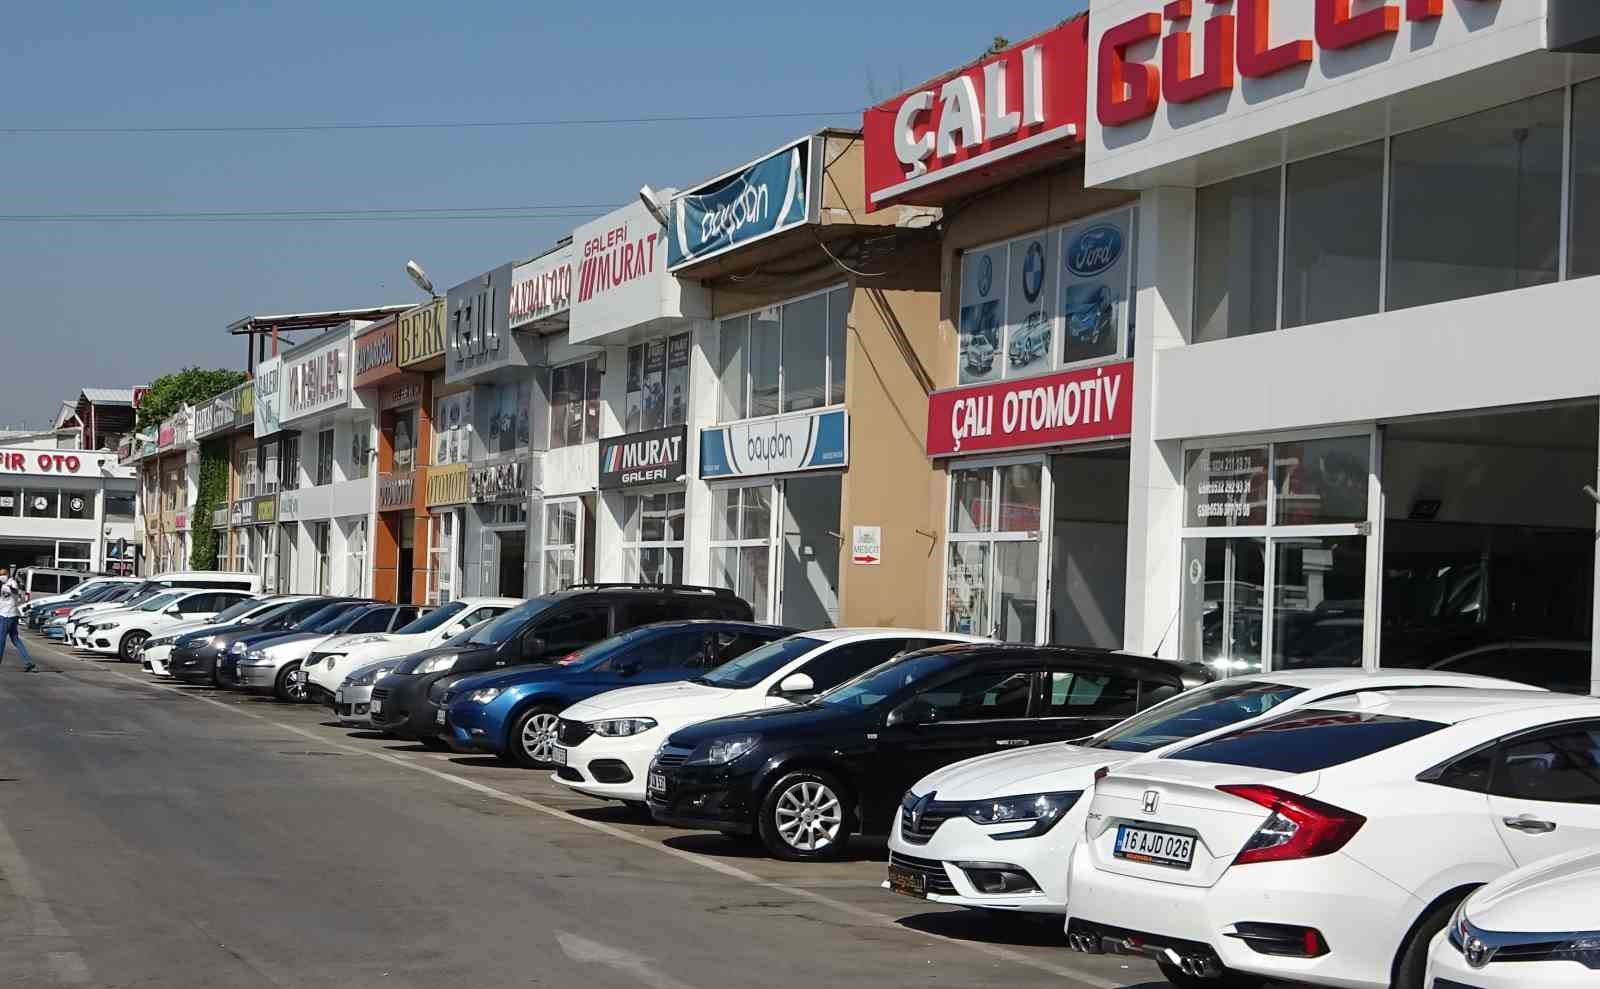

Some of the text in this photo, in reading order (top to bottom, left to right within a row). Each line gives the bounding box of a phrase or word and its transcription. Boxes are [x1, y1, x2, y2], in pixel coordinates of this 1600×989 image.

[894, 45, 1045, 180] ÇALI
[584, 220, 628, 258] GALERİ
[1076, 232, 1113, 269] Ford
[596, 233, 657, 293] MURAT
[551, 264, 571, 303] OTO
[401, 302, 446, 365] BERK
[952, 368, 1121, 451] ÇALI OTOMOTİV
[37, 454, 81, 473] OTO
[622, 436, 682, 469] MURAT
[747, 420, 793, 470] baydan
[1124, 831, 1138, 850] 16
[1139, 833, 1163, 854] AJD
[1165, 837, 1190, 858] 026
